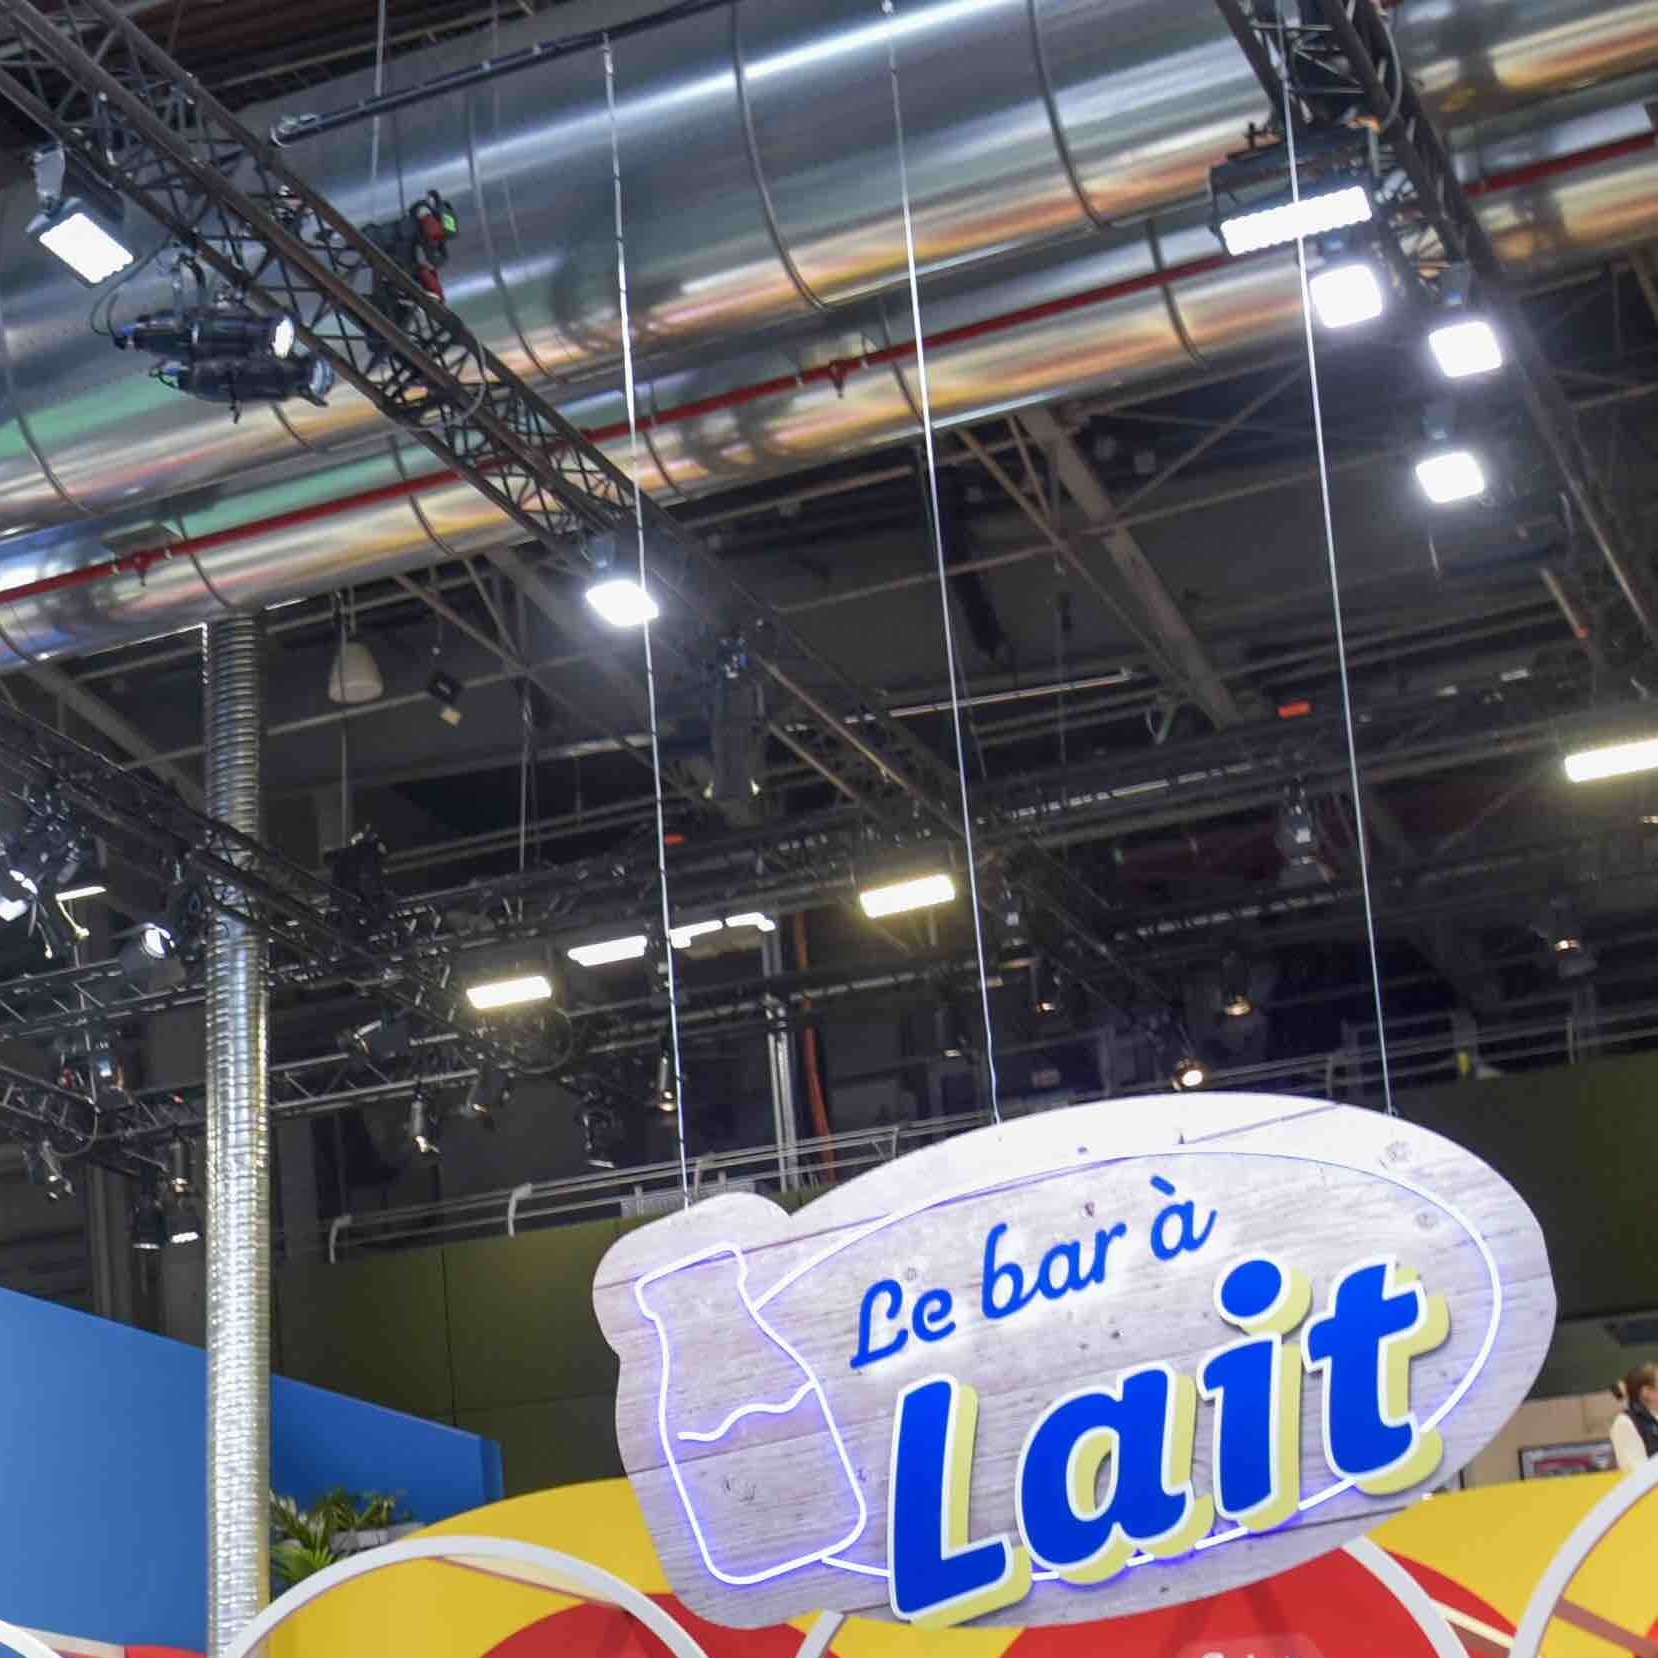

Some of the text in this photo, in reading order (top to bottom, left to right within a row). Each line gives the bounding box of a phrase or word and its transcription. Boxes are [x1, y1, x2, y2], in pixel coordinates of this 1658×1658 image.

[847, 1174, 1217, 1368] Le bar à
[886, 1258, 1429, 1624] Lait
